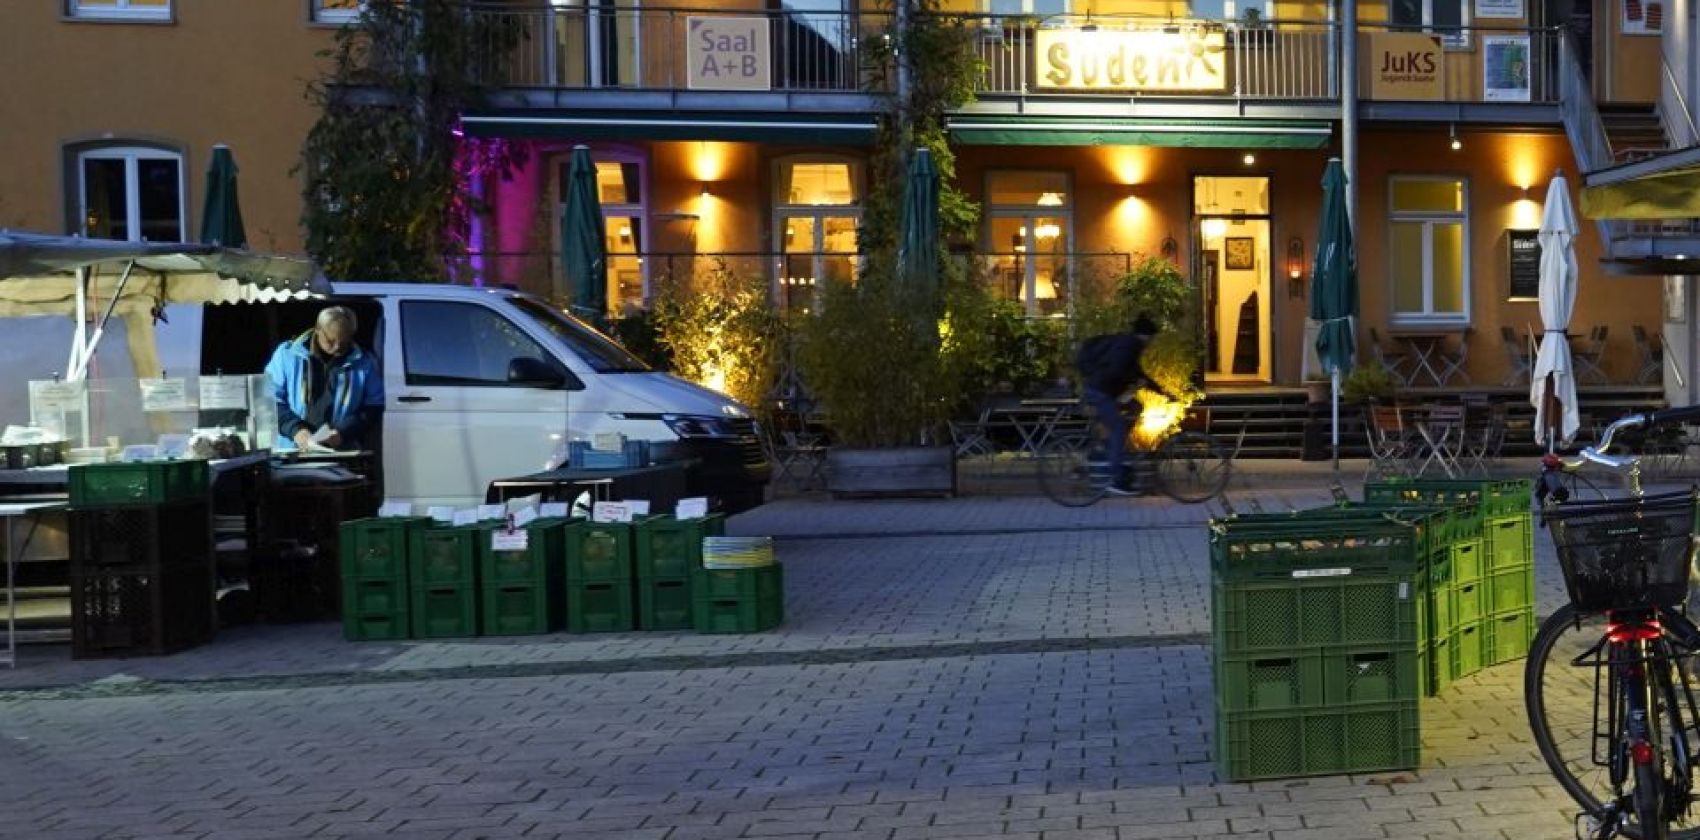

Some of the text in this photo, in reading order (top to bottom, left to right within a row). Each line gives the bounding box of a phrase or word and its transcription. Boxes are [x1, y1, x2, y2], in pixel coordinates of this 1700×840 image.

[701, 28, 756, 52] Saal
[701, 54, 757, 77] A+B
[1381, 51, 1436, 74] JuKS
